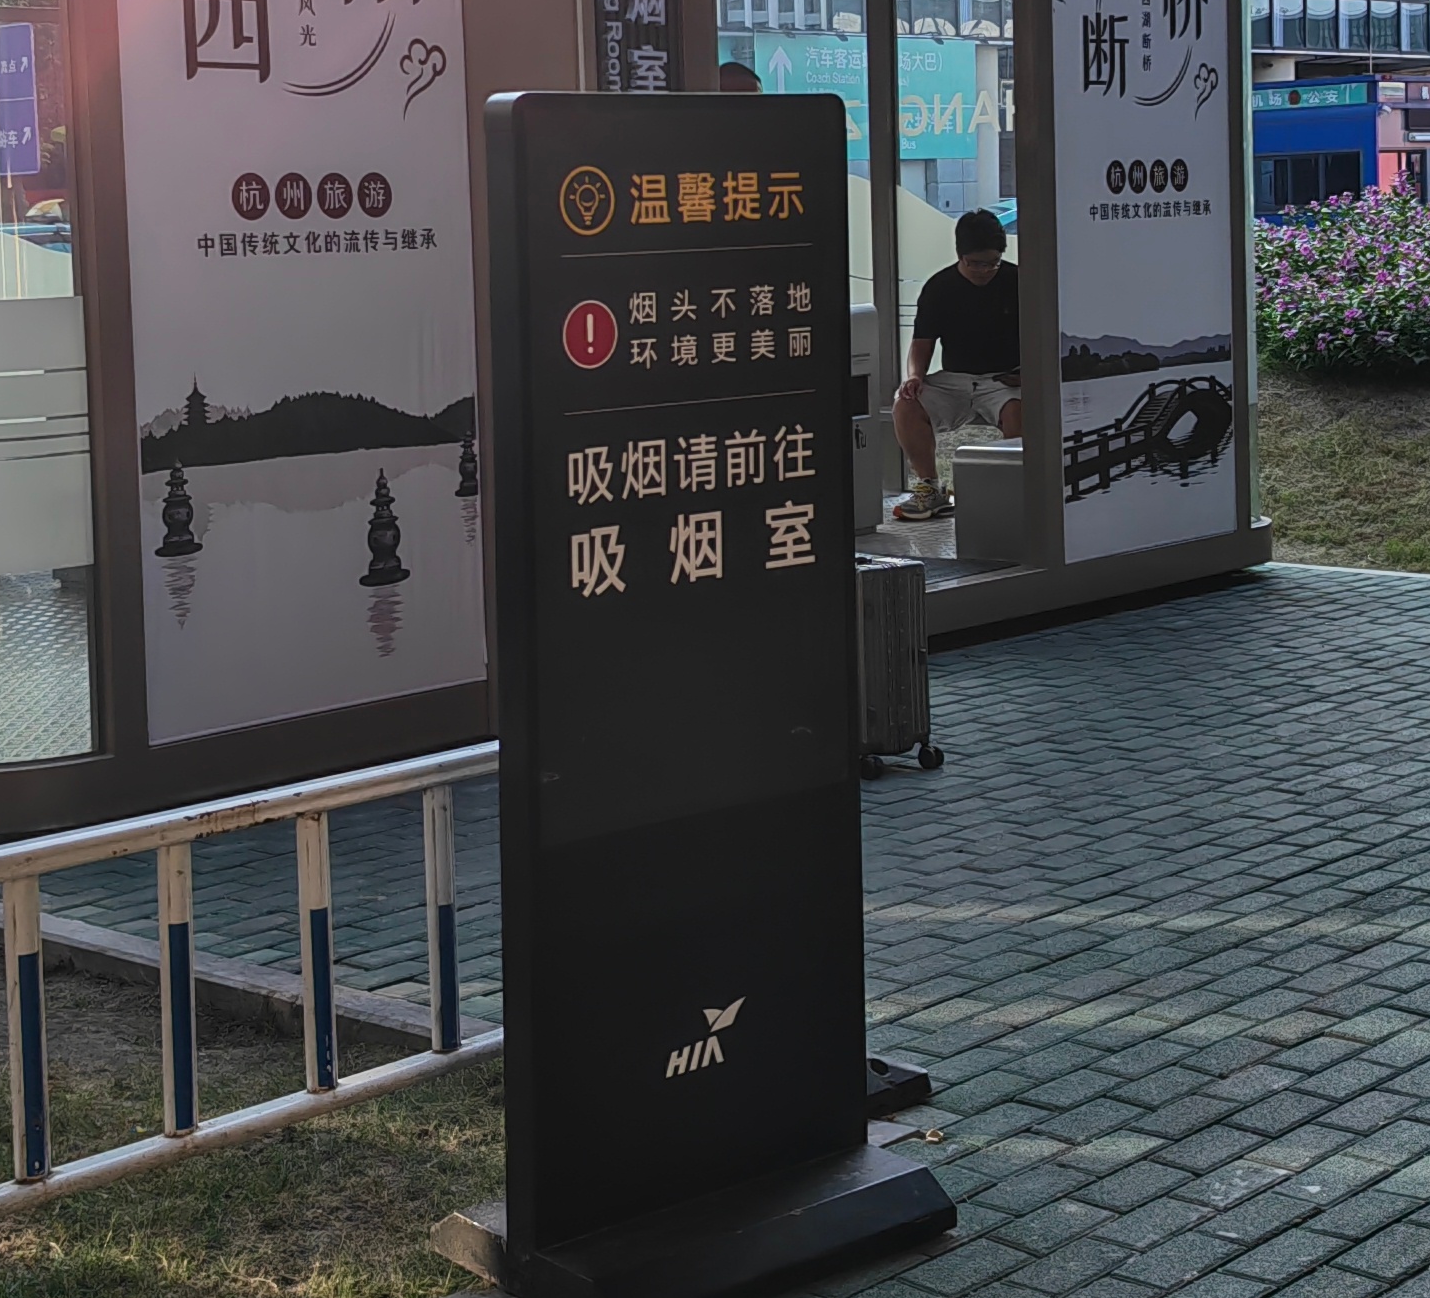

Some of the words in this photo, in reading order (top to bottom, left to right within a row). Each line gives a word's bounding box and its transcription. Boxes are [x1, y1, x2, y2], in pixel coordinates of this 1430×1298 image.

[805, 46, 868, 70] 汽车客运
[805, 71, 831, 84] Coach
[831, 72, 861, 85] Station
[900, 137, 917, 150] Bus
[1109, 163, 1187, 188] 杭州旅游
[238, 176, 389, 213] 杭州旅游
[629, 170, 805, 226] 温馨提示
[1088, 198, 1212, 222] 中国传统文化的流传与继承
[196, 226, 438, 259] 中国传统文化的流传与继承
[628, 281, 813, 325] 烟头不落地
[629, 326, 812, 371] 环境更美丽
[566, 423, 817, 506] 吸烟请前往
[570, 499, 817, 599] 吸烟室
[665, 1034, 725, 1079] HIA
